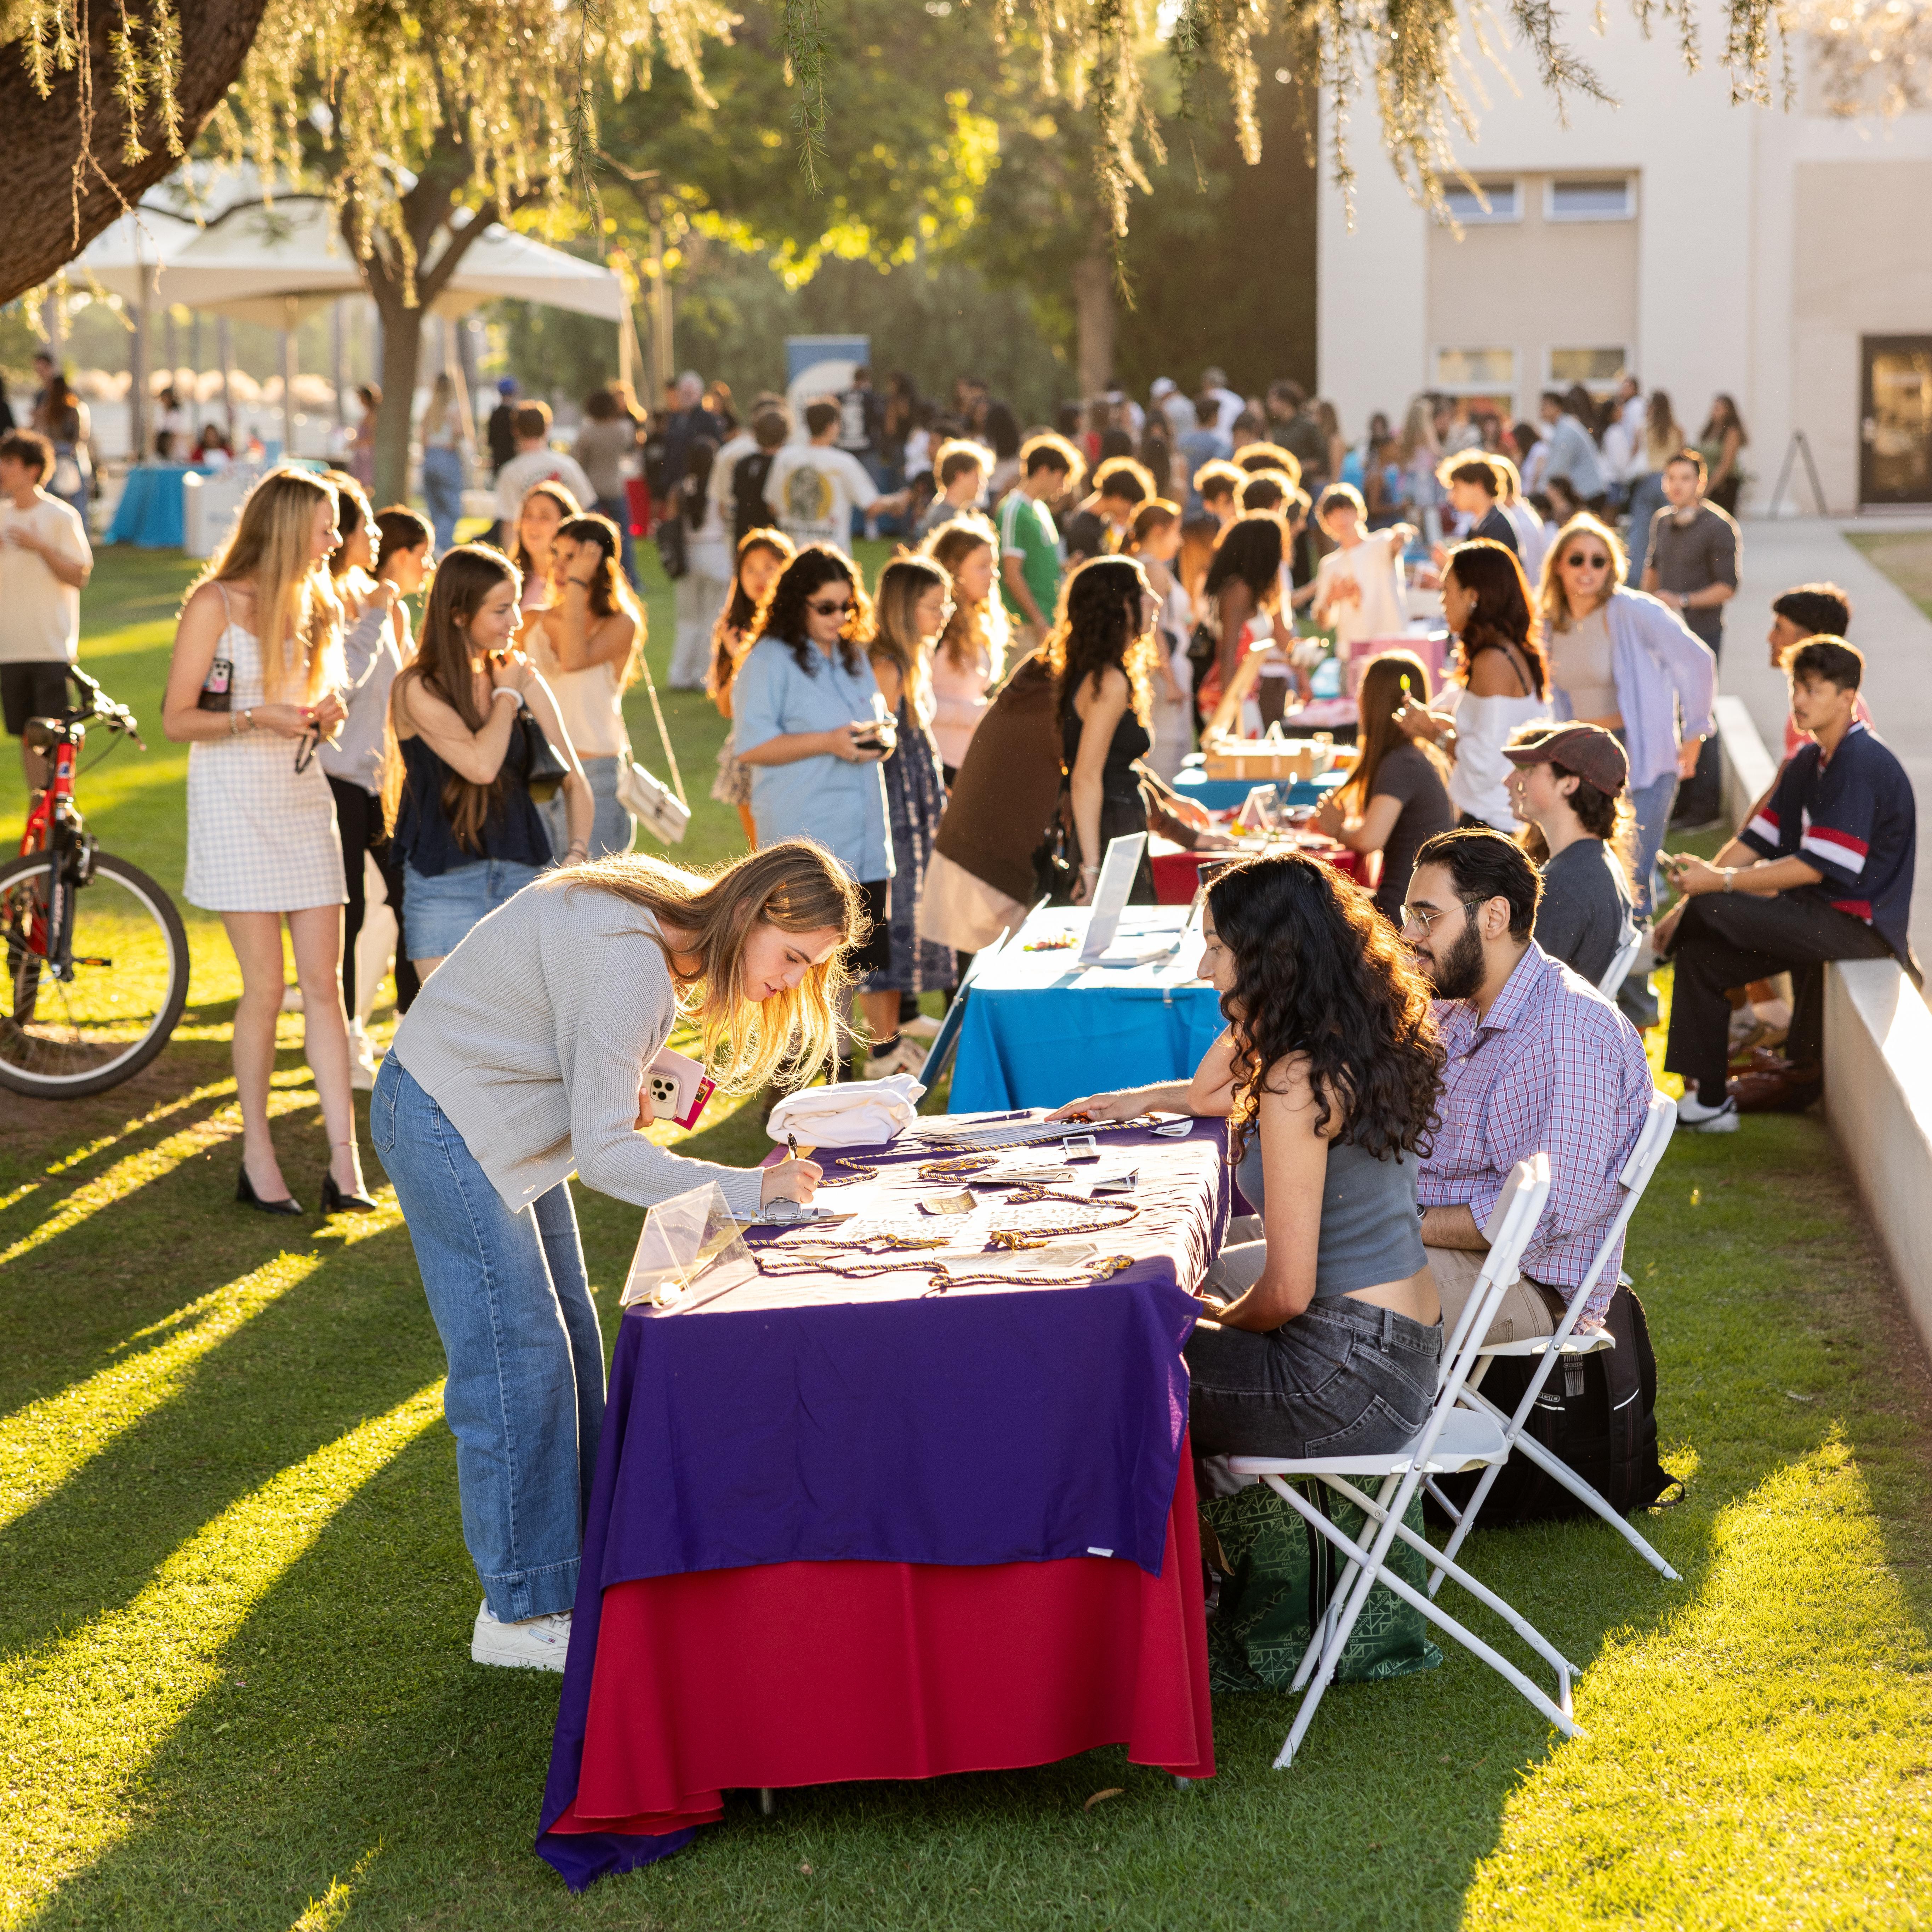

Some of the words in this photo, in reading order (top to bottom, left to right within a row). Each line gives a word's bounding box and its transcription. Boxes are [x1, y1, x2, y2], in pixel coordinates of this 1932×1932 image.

[1239, 1495, 1255, 1517] HARRODS
[1273, 1509, 1298, 1518] HARRODS
[1225, 1519, 1248, 1528] HARRODS
[1266, 1520, 1283, 1541] HARRODS
[1282, 1558, 1306, 1567] HARRODS
[1372, 1593, 1390, 1613] HARRODS
[1351, 1616, 1369, 1636] HARRODS
[1274, 1650, 1292, 1669] HARRODS
